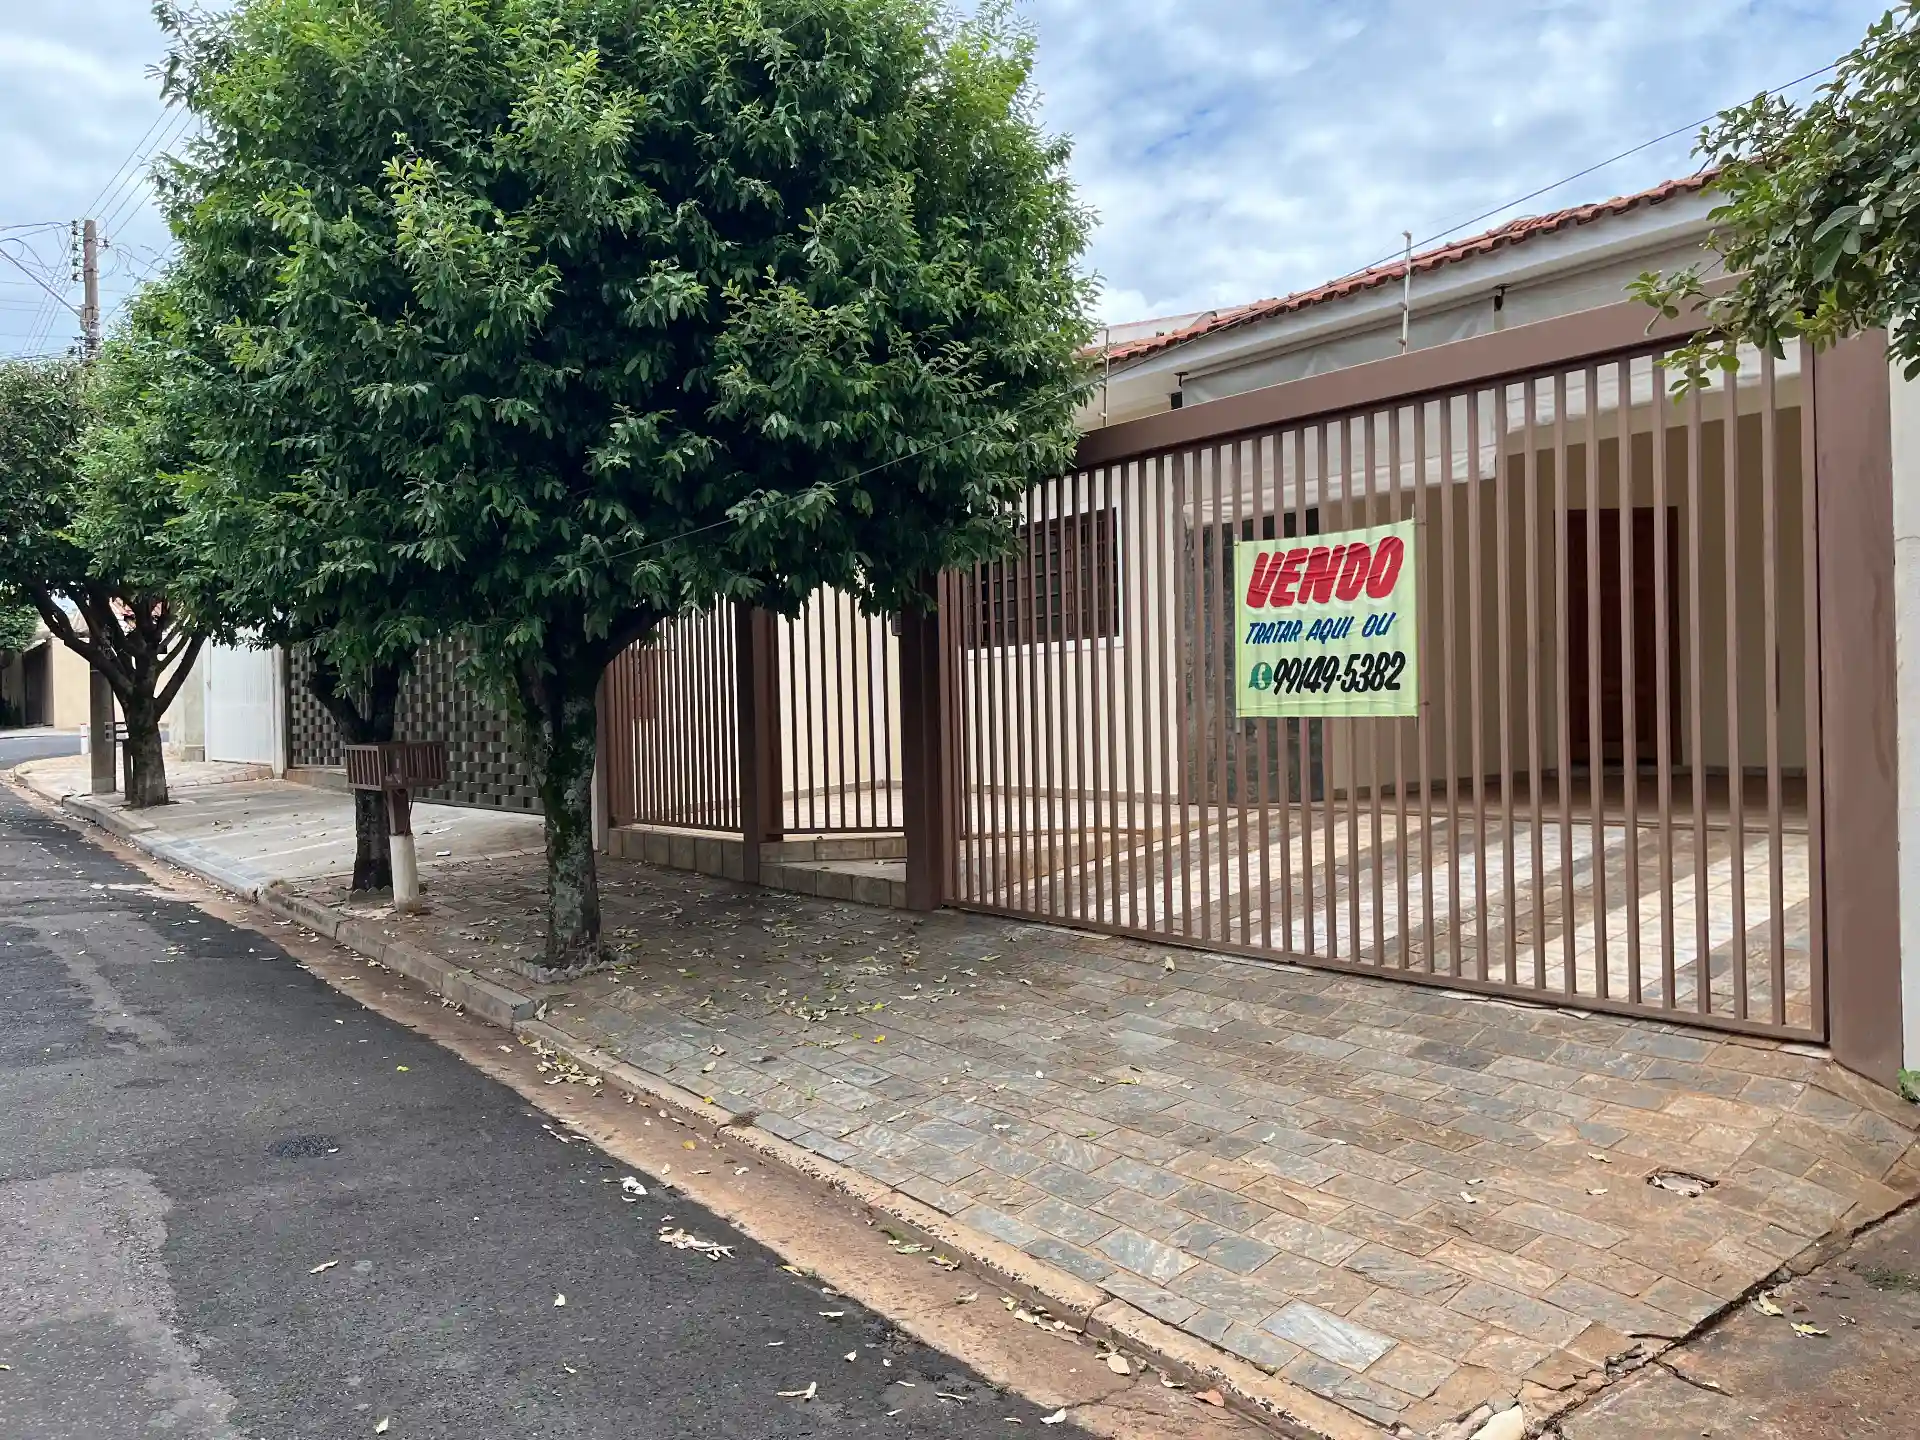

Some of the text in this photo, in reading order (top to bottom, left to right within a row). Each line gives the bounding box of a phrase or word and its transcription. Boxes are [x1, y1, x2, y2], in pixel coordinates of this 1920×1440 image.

[1246, 536, 1404, 608] VENDO
[1245, 612, 1396, 644] TRATAR AQUI OU
